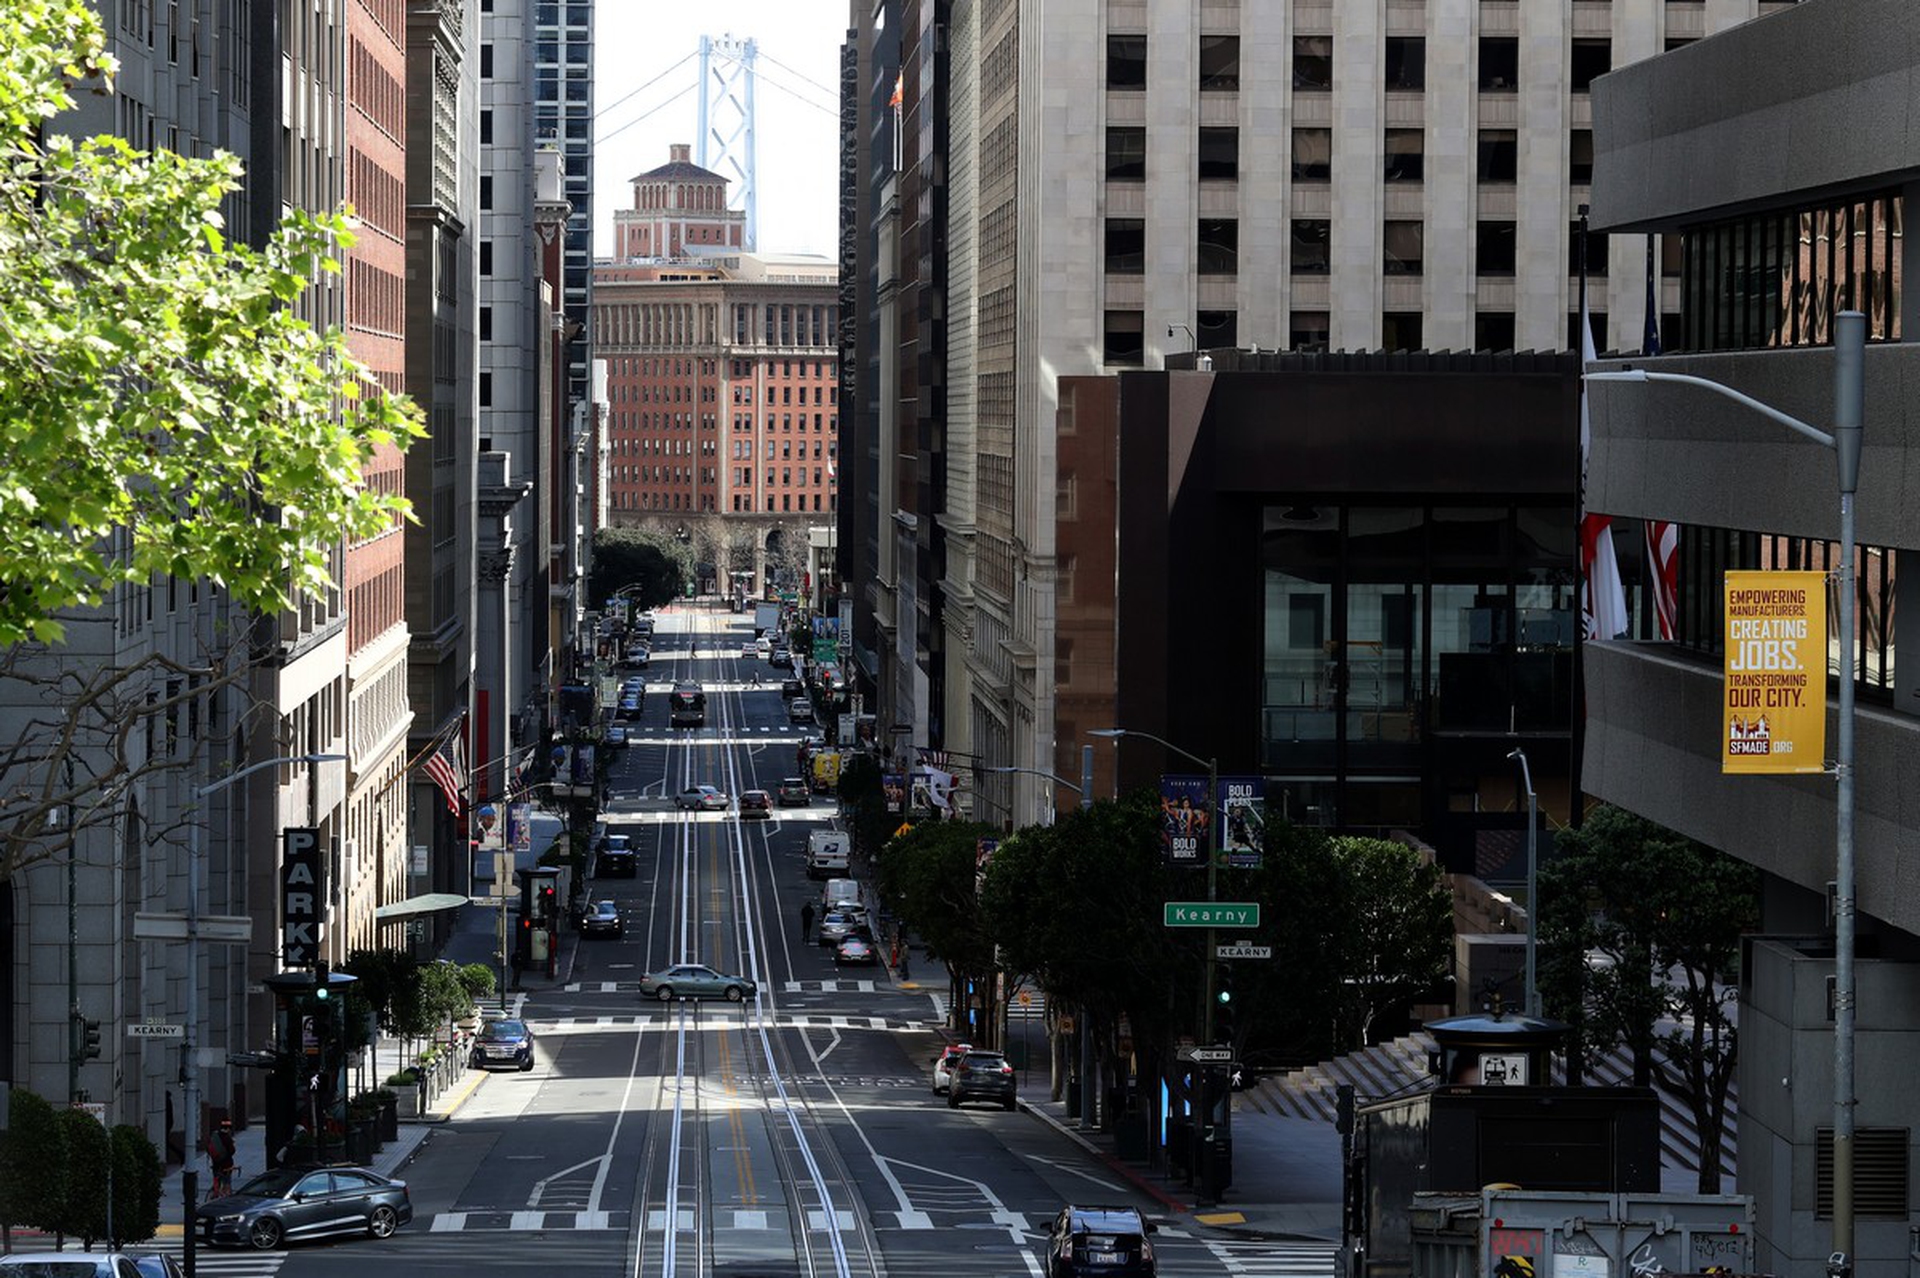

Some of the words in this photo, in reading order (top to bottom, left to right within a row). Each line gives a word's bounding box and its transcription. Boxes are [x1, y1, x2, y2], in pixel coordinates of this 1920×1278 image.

[1730, 590, 1806, 604] EMPOWERING
[1729, 605, 1807, 617] MANUFACTURERS.
[1730, 619, 1807, 639] CREATING
[1730, 640, 1804, 671] JOBS.
[1729, 674, 1807, 687] TRANSFORMING
[1729, 688, 1761, 708] OUR
[1767, 688, 1806, 708] CITY.
[1730, 740, 1769, 754] SFMADE
[1228, 784, 1253, 797] BOLD
[1172, 837, 1197, 850] BOLD
[286, 832, 315, 945] PARK
[1175, 908, 1247, 924] Kearny
[1220, 947, 1268, 957] KEARNY
[134, 1026, 177, 1035] KEARNY
